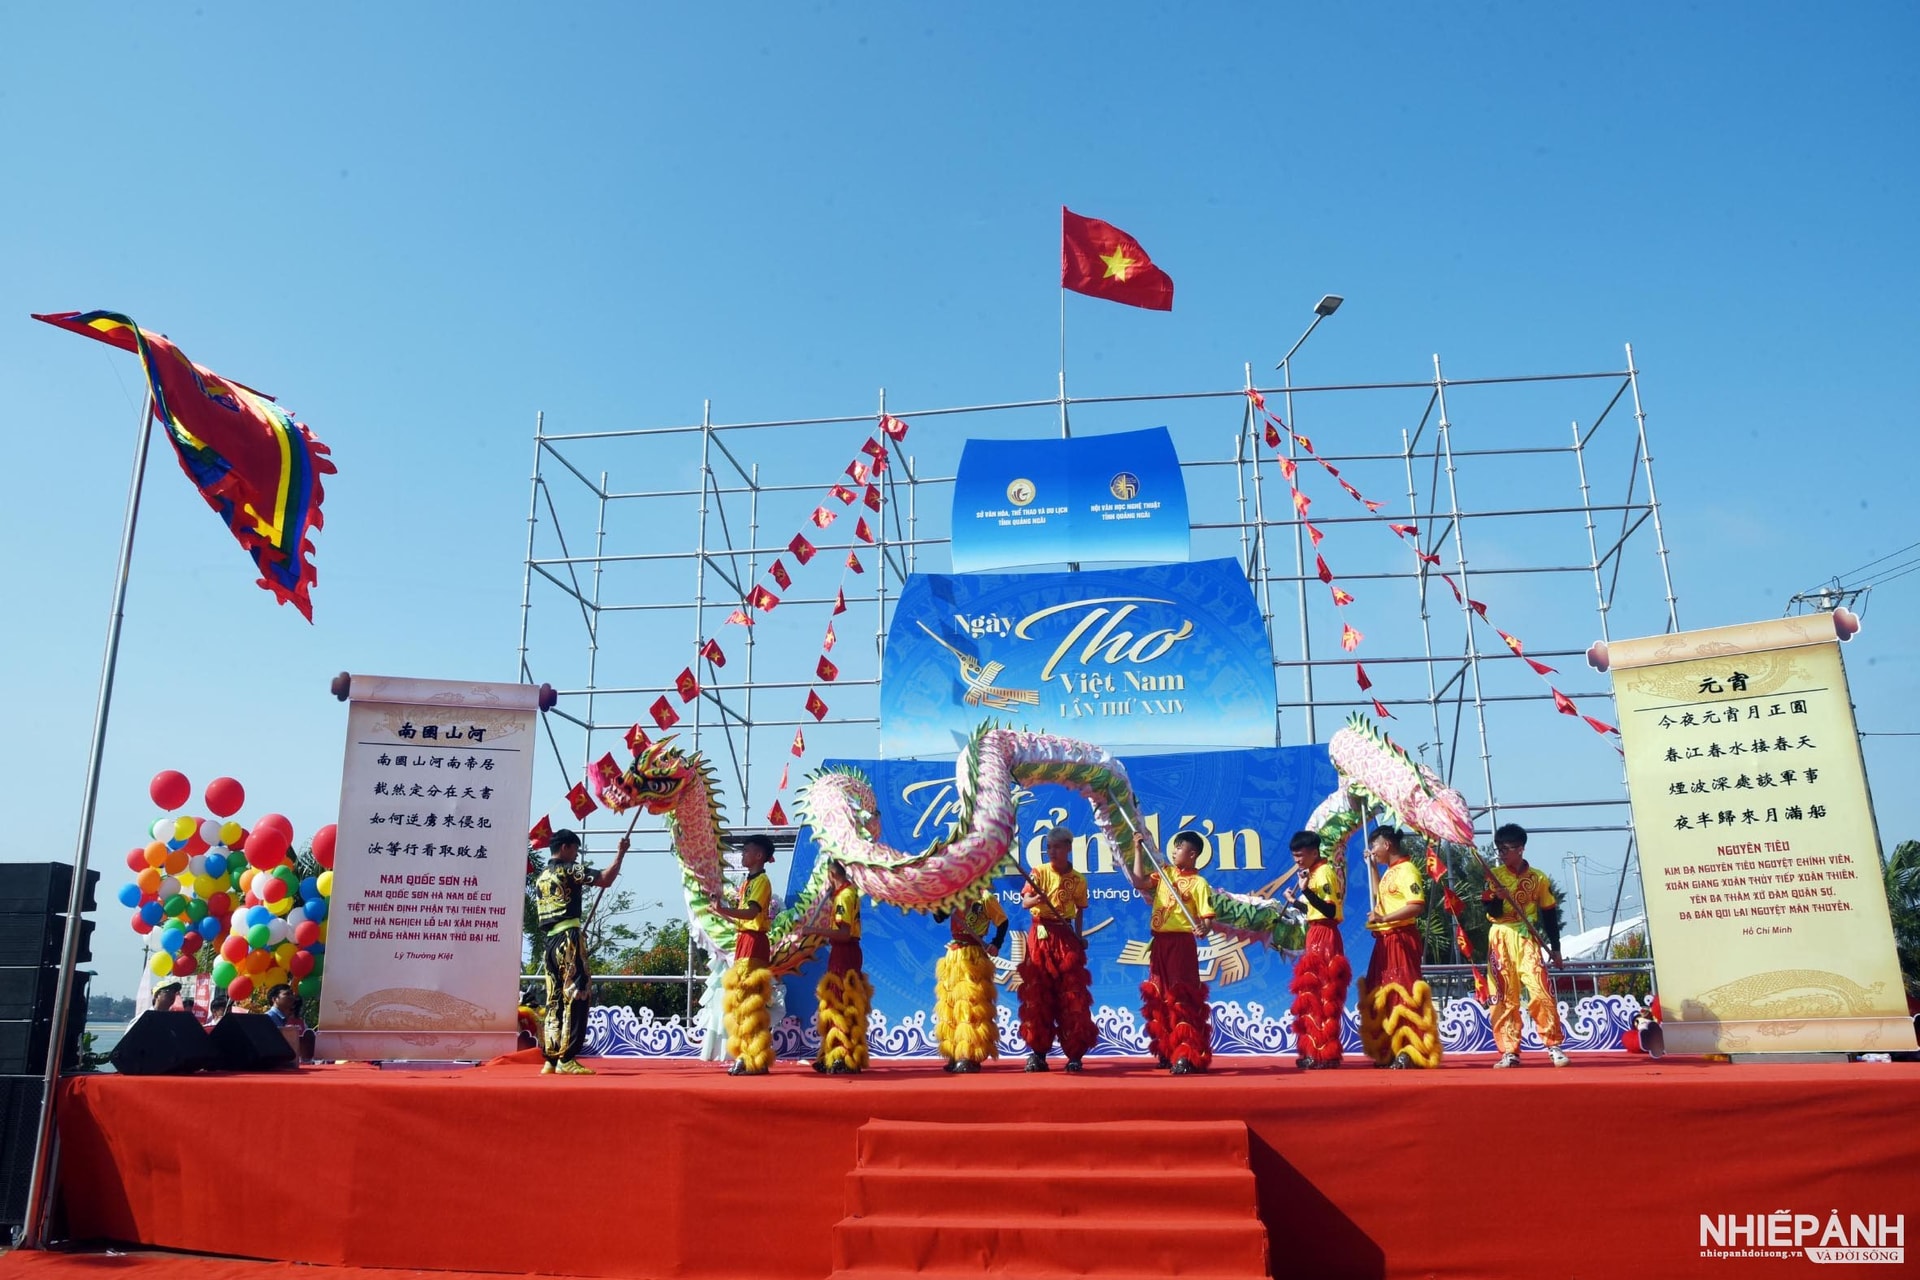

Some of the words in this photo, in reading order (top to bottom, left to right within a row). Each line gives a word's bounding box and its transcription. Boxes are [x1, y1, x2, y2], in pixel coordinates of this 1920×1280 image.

[954, 612, 1016, 639] Ngày
[1014, 597, 1195, 682] Thơ
[1059, 671, 1116, 698] Việt
[1123, 670, 1185, 691] Nam
[1698, 672, 1749, 694] 元宵
[1060, 698, 1096, 718] LẦN
[1142, 699, 1185, 716] XXIV
[1664, 735, 1816, 762] 春江春水接春天
[1717, 842, 1761, 856] NGUYÊN
[1765, 840, 1790, 852] TIÊU
[1664, 866, 1680, 876] KIM
[1698, 861, 1733, 873] NGUYÊN
[1735, 860, 1755, 870] TIÊU
[1758, 858, 1793, 870] NGUYỆT
[1797, 855, 1825, 867] CHÍNH
[1829, 855, 1854, 865] VIÊN.
[380, 875, 402, 884] NAM
[406, 873, 435, 886] QUỐC
[439, 876, 460, 886] SƠN
[463, 875, 478, 886] HÀ
[1665, 879, 1689, 890] XUÂN
[1692, 879, 1719, 889] GIANG
[1722, 876, 1746, 887] XUÂN
[1775, 871, 1795, 884] TIẾP
[1798, 872, 1824, 882] XUÂN
[1826, 870, 1858, 880] THIÊN.
[364, 890, 382, 898] NAM
[386, 889, 409, 899] QUỐC
[411, 890, 428, 899] SƠN
[431, 890, 443, 899] HÀ
[446, 892, 464, 900] NAM
[1093, 888, 1130, 902] tháng
[1690, 892, 1707, 904] YÊN
[1710, 893, 1722, 903] BA
[1724, 890, 1750, 901] THÂM
[1792, 887, 1818, 899] QUÂN
[347, 902, 365, 913] TIỆT
[368, 903, 394, 912] NHIÊN
[397, 905, 417, 914] ĐỊNH
[420, 903, 443, 914] PHẬN
[446, 906, 459, 915] TẠI
[462, 906, 486, 914] THIÊN
[489, 907, 506, 915] THƯ
[1716, 908, 1731, 920] QUI
[1734, 907, 1748, 917] LAI
[1751, 905, 1786, 917] NGUYỆT
[374, 916, 386, 925] HÀ
[389, 918, 421, 928] NGHỊCH
[438, 919, 451, 927] LAI
[454, 918, 472, 928] XÂM
[474, 919, 498, 930] PHẠM
[1743, 926, 1754, 935] Hồ
[1756, 926, 1770, 935] Chí
[1772, 926, 1792, 934] Minh
[396, 931, 420, 940] HÀNH
[423, 932, 447, 940] KHAN
[470, 933, 483, 943] BẠI
[394, 952, 403, 960] Lý
[406, 952, 436, 960] Thường
[438, 952, 453, 960] Kiệt
